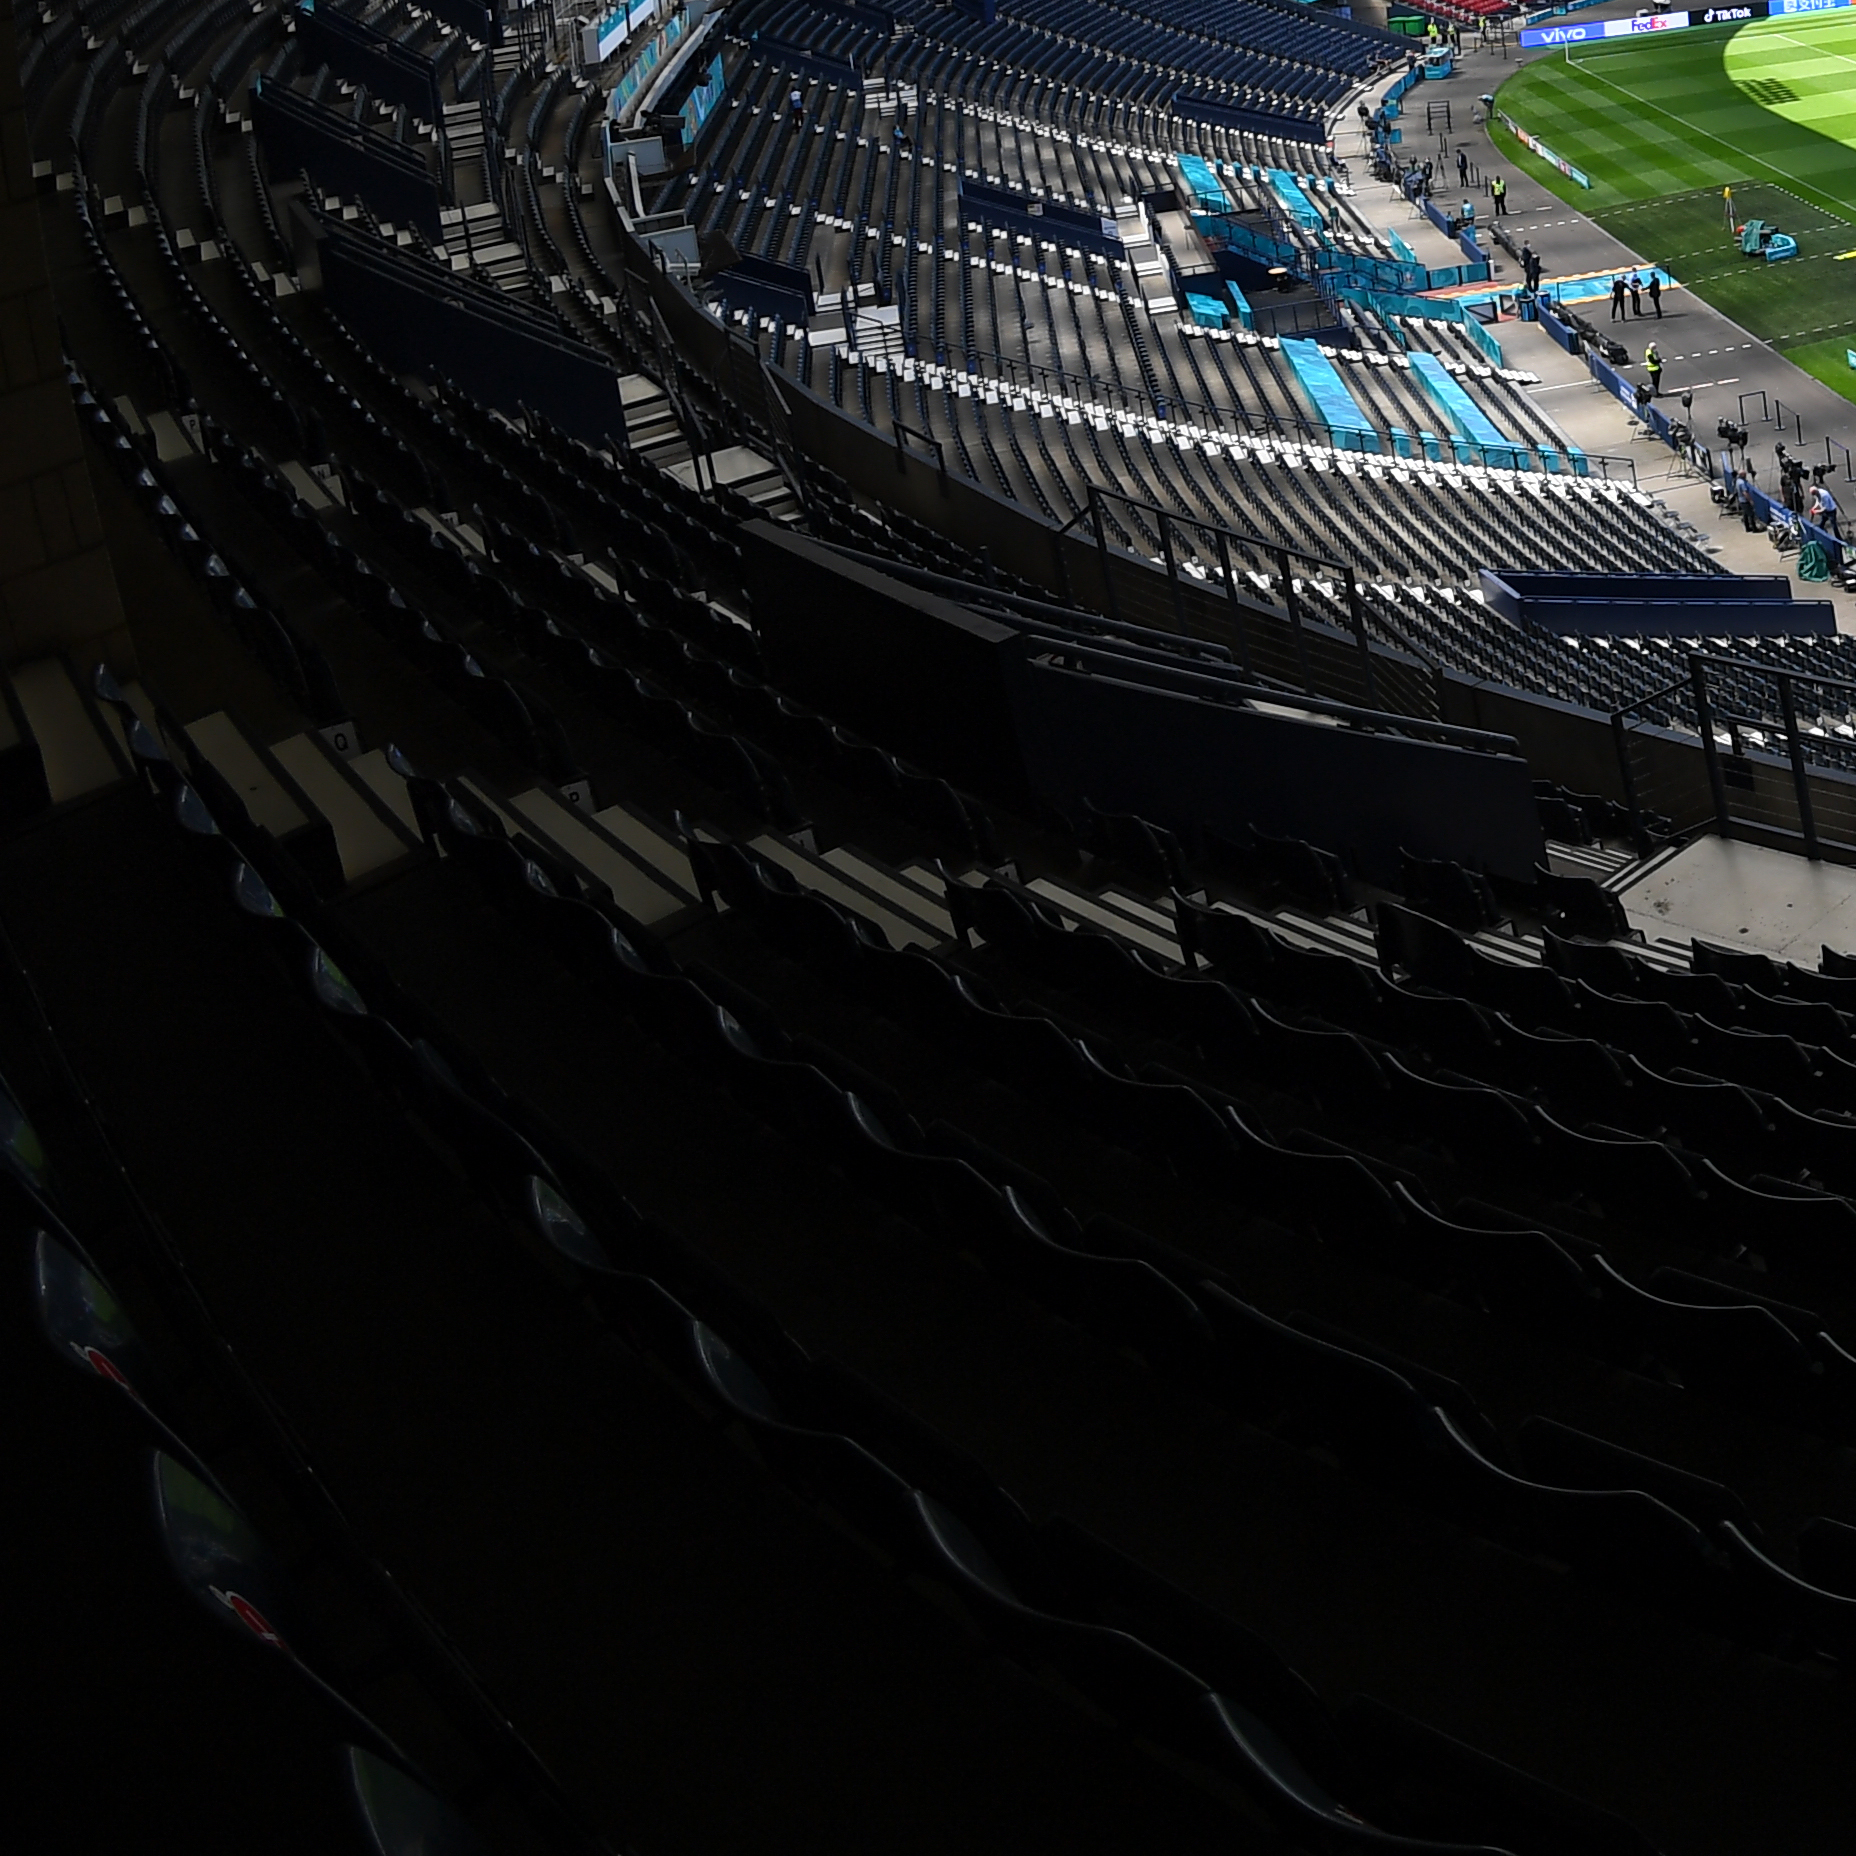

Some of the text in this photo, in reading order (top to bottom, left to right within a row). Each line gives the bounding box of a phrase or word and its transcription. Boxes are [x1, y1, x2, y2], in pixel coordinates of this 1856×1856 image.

[1715, 7, 1752, 21] TikTok
[1631, 17, 1668, 32] FedEx
[1541, 27, 1586, 43] vivo
